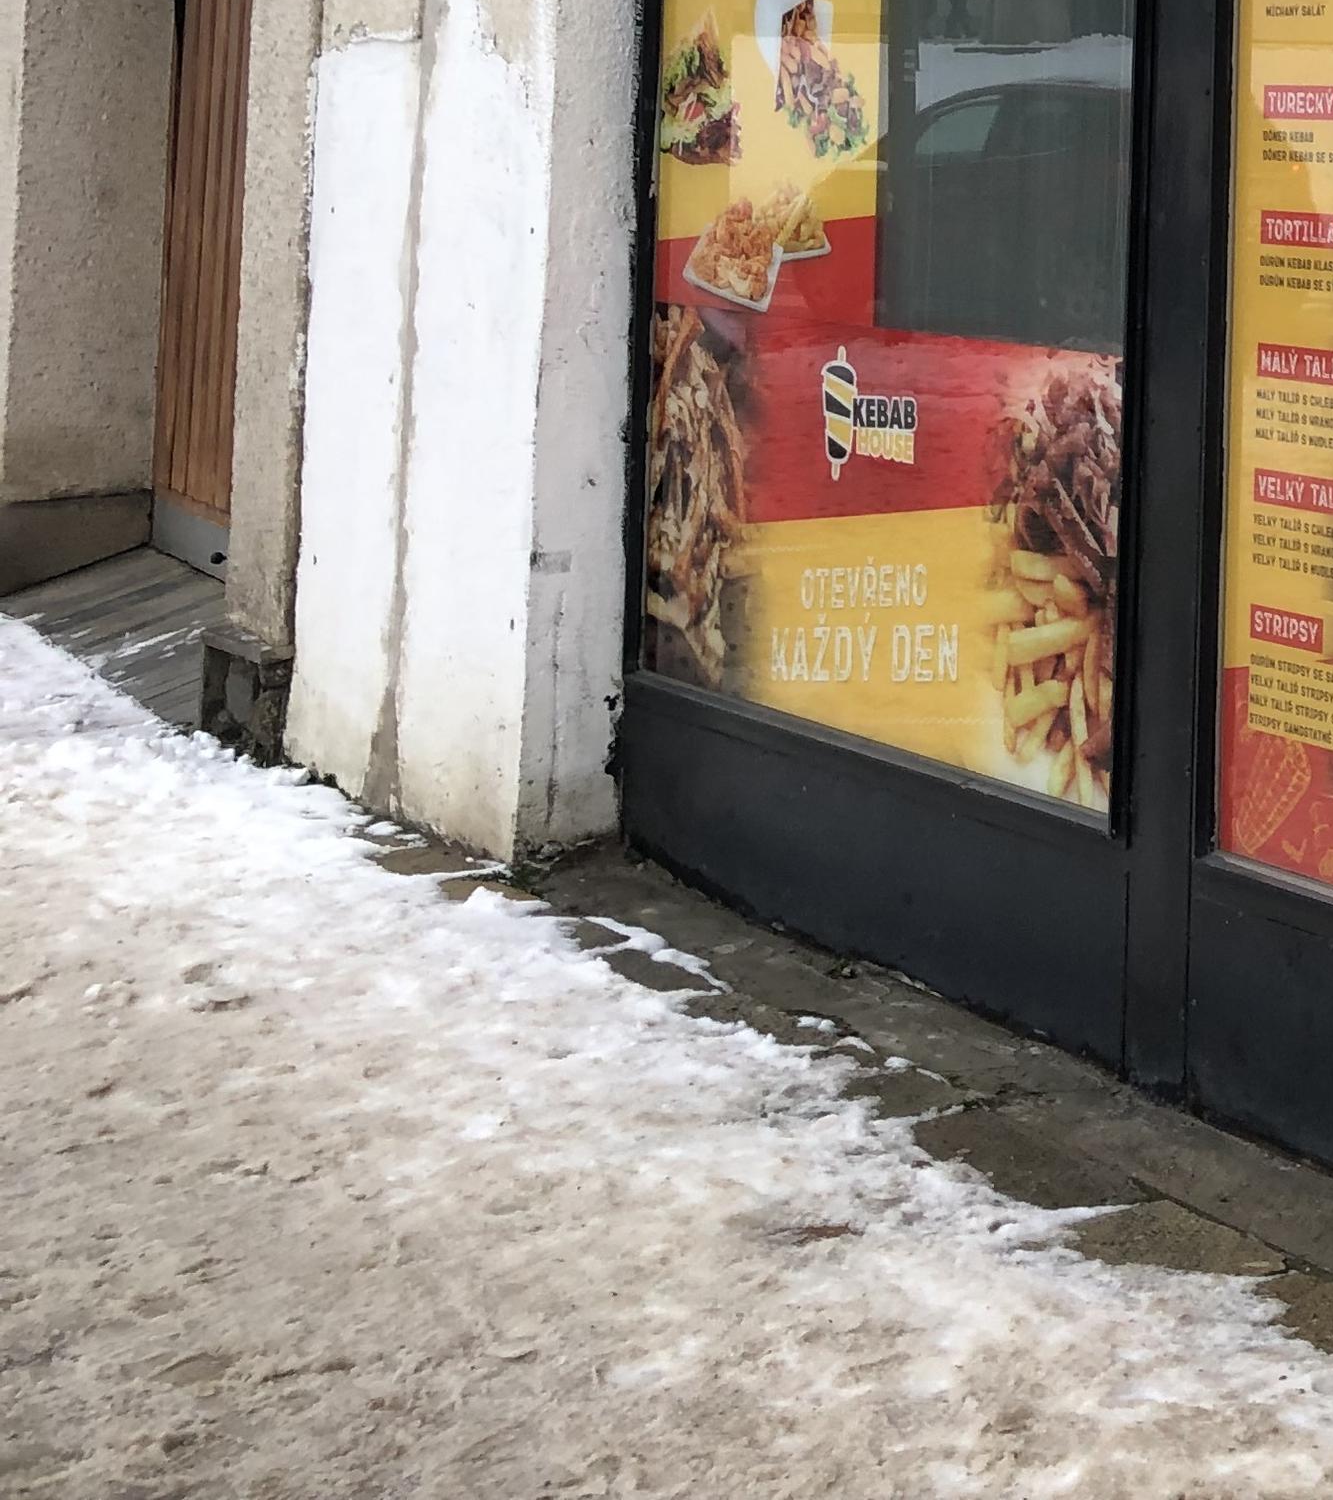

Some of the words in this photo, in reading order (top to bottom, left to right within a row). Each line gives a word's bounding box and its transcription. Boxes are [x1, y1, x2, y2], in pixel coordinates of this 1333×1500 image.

[1301, 4, 1326, 17] SALÁT
[1260, 348, 1298, 375] MALÝ
[851, 397, 917, 431] KEBAB
[855, 428, 916, 465] HOUSE
[1258, 474, 1305, 504] VELKÝ
[801, 556, 928, 609] OTEVŘENO
[1254, 609, 1319, 645] STRIPSY
[770, 612, 877, 682] KAŽDÝ
[891, 623, 959, 683] DEN
[1249, 712, 1281, 733] STRIPSY
